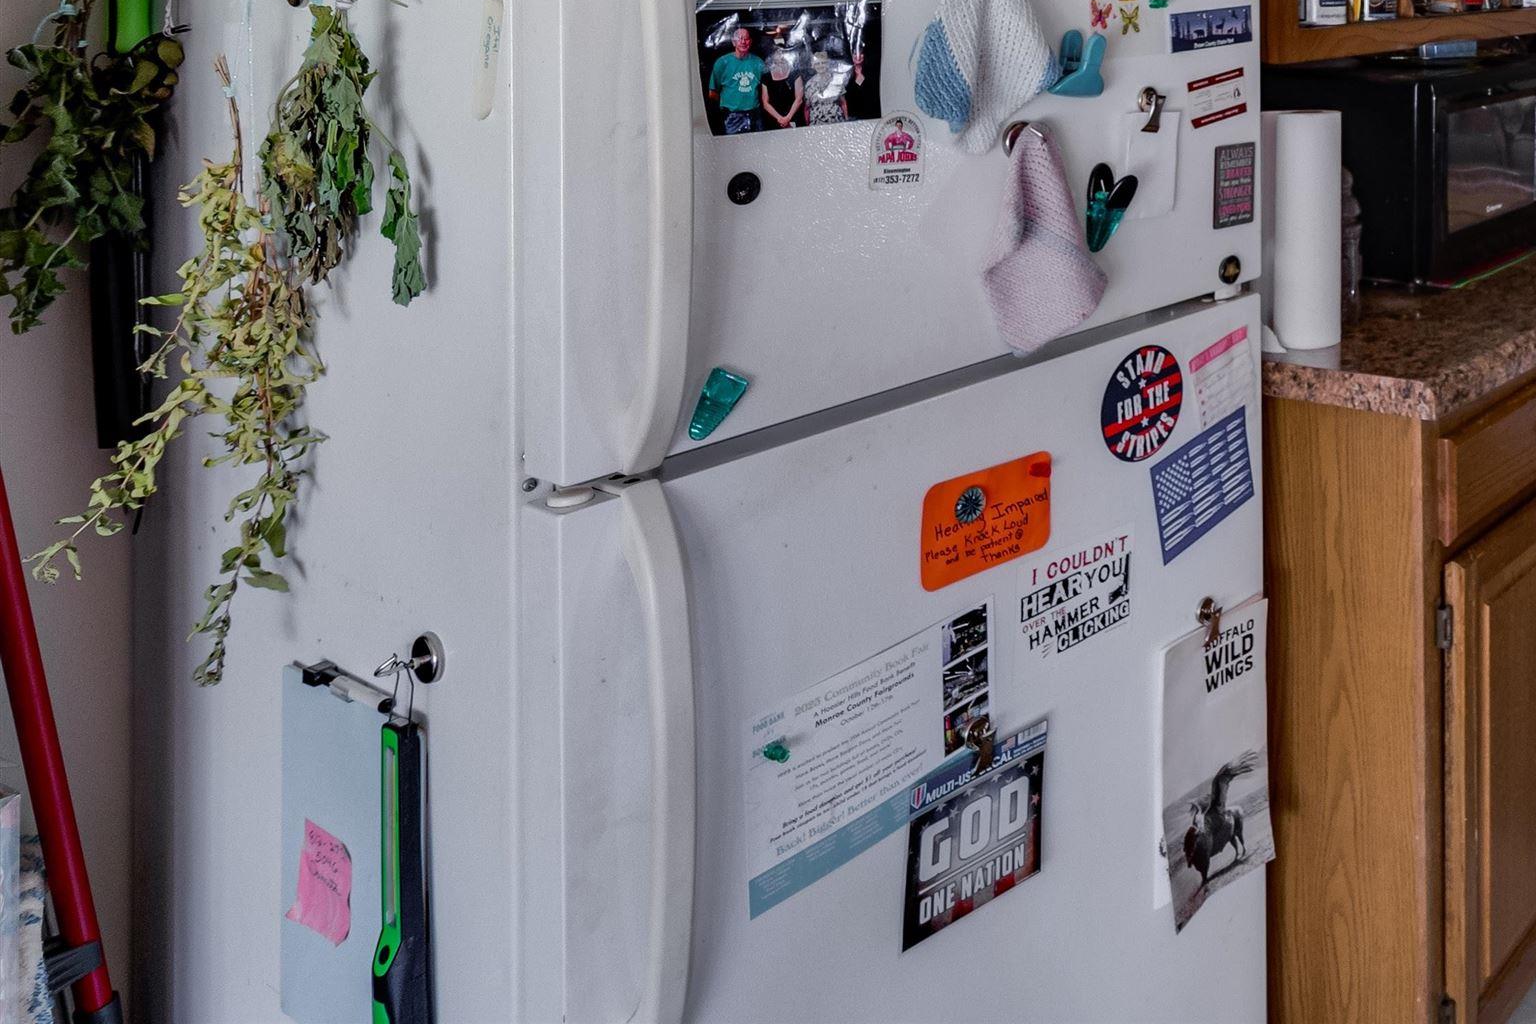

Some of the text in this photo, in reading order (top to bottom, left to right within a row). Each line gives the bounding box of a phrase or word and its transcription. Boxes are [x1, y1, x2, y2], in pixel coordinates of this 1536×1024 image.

[878, 152, 895, 164] PAPA
[1116, 350, 1166, 389] STAND
[1116, 393, 1143, 424] FOR
[1146, 380, 1170, 409] THE
[1116, 412, 1175, 458] STRIPES
[925, 544, 958, 562] Please
[1032, 535, 1129, 586] I COULDN'T
[1021, 557, 1123, 622] HEAR YOU
[1022, 606, 1066, 634] OVER THE
[1029, 596, 1100, 650] HAMMER
[1057, 599, 1130, 653] CLICKING
[823, 668, 883, 702] Community
[885, 655, 909, 672] Book
[911, 644, 929, 658] Fair
[1204, 633, 1254, 675] WILD
[1205, 655, 1253, 694] WINGS
[815, 672, 915, 728] Monroe County Fairgrounds
[862, 681, 878, 693] Food
[880, 673, 894, 685] Bank
[840, 711, 865, 726] October
[847, 795, 876, 816] Better
[926, 768, 977, 805] MULTI-US
[918, 775, 1031, 883] GOD
[919, 882, 956, 925] ONE
[960, 843, 1025, 900] NATION
